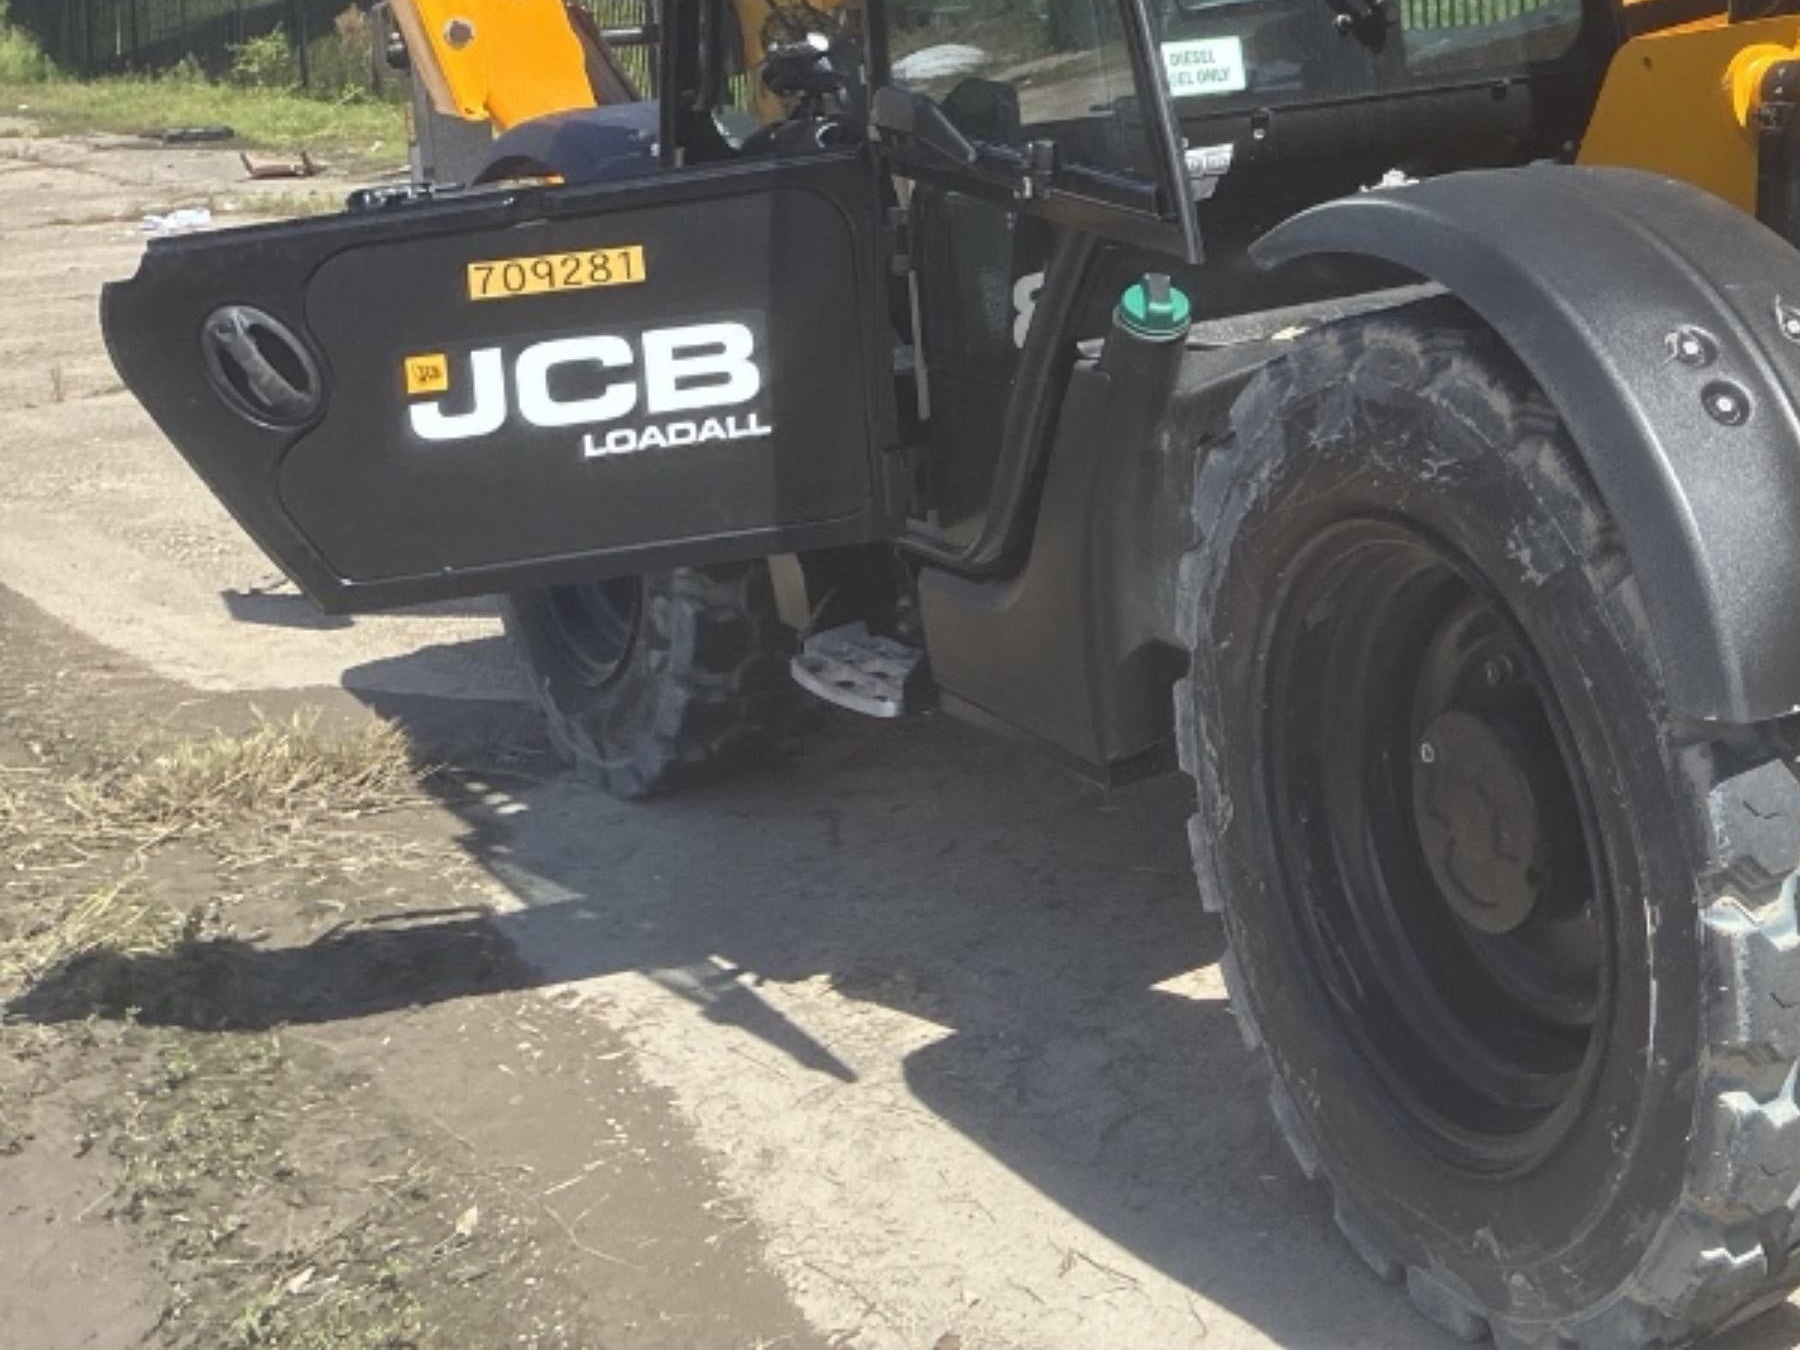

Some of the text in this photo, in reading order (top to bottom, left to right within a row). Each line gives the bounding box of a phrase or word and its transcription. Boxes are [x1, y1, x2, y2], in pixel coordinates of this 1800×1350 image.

[1169, 49, 1217, 66] DIESEL
[1197, 66, 1231, 84] ONLY
[473, 250, 636, 296] 709281
[409, 322, 761, 440] JCB
[583, 412, 773, 458] LOADALL
